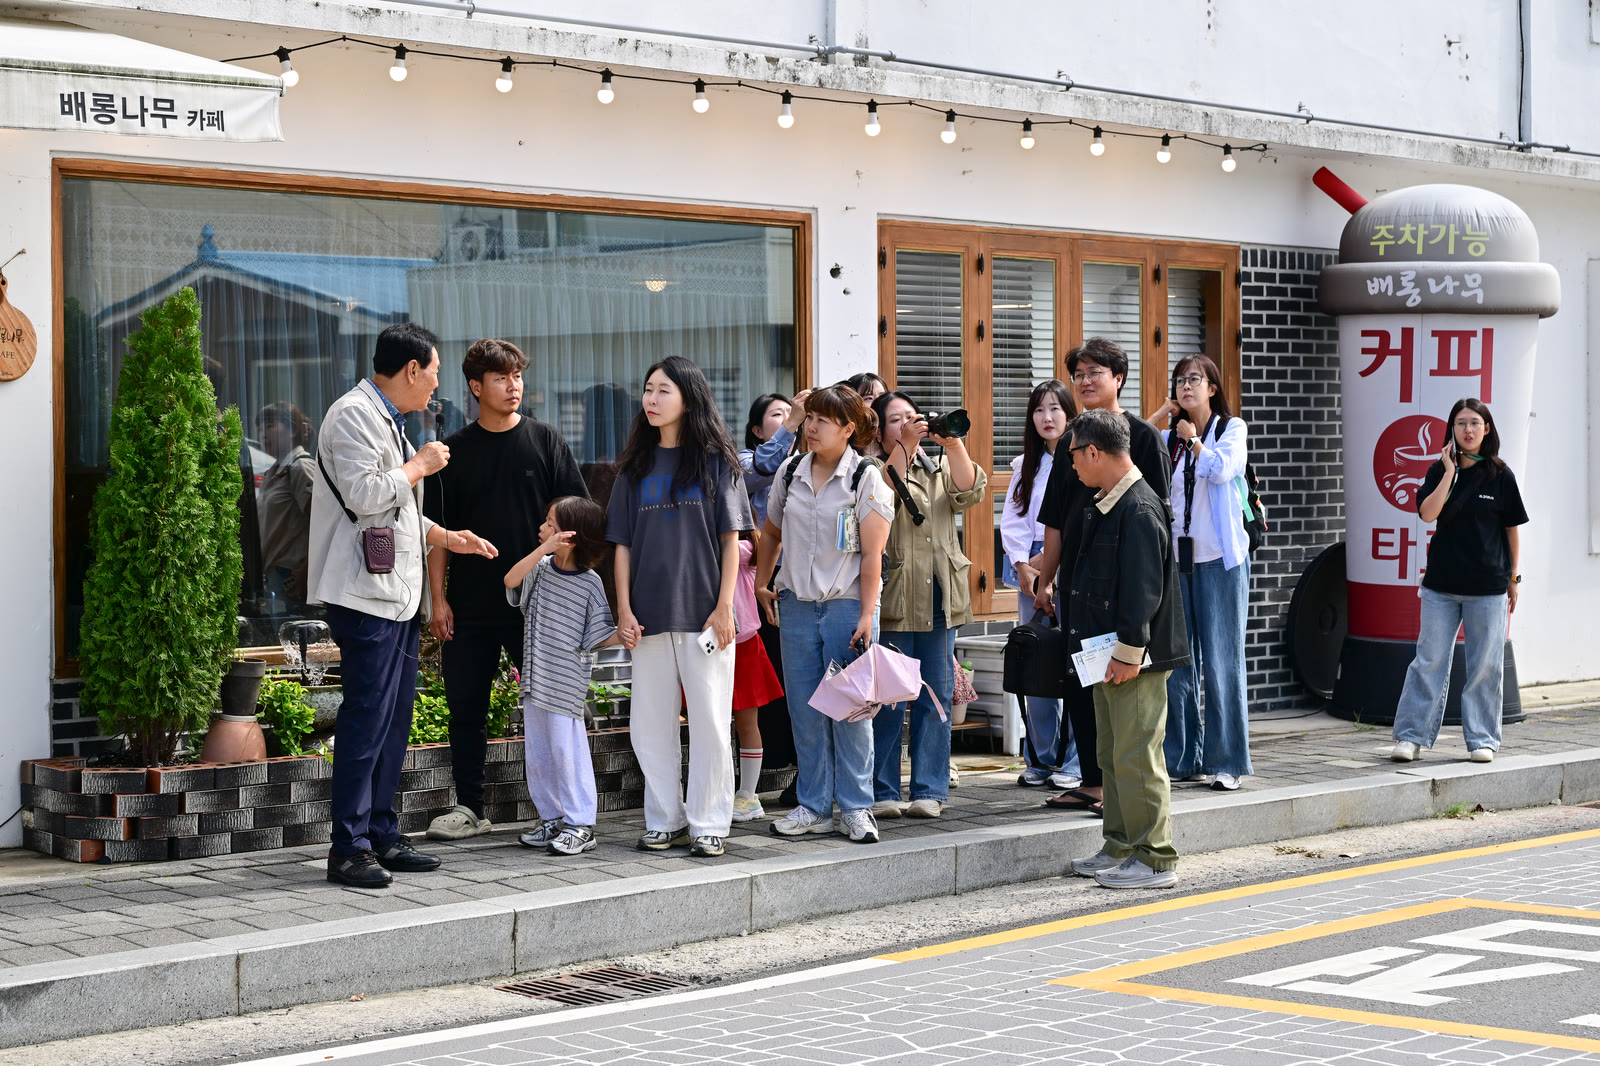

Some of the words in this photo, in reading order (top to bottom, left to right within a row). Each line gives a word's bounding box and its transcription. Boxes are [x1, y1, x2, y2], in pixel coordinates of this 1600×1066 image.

[59, 91, 178, 129] 배롱나무
[186, 108, 225, 132] 카페
[1369, 223, 1490, 257] 주차가능
[1366, 270, 1484, 308] 배롱나무
[0, 351, 15, 359] AFE
[1358, 327, 1494, 404] 커피
[1371, 527, 1437, 579] 타
